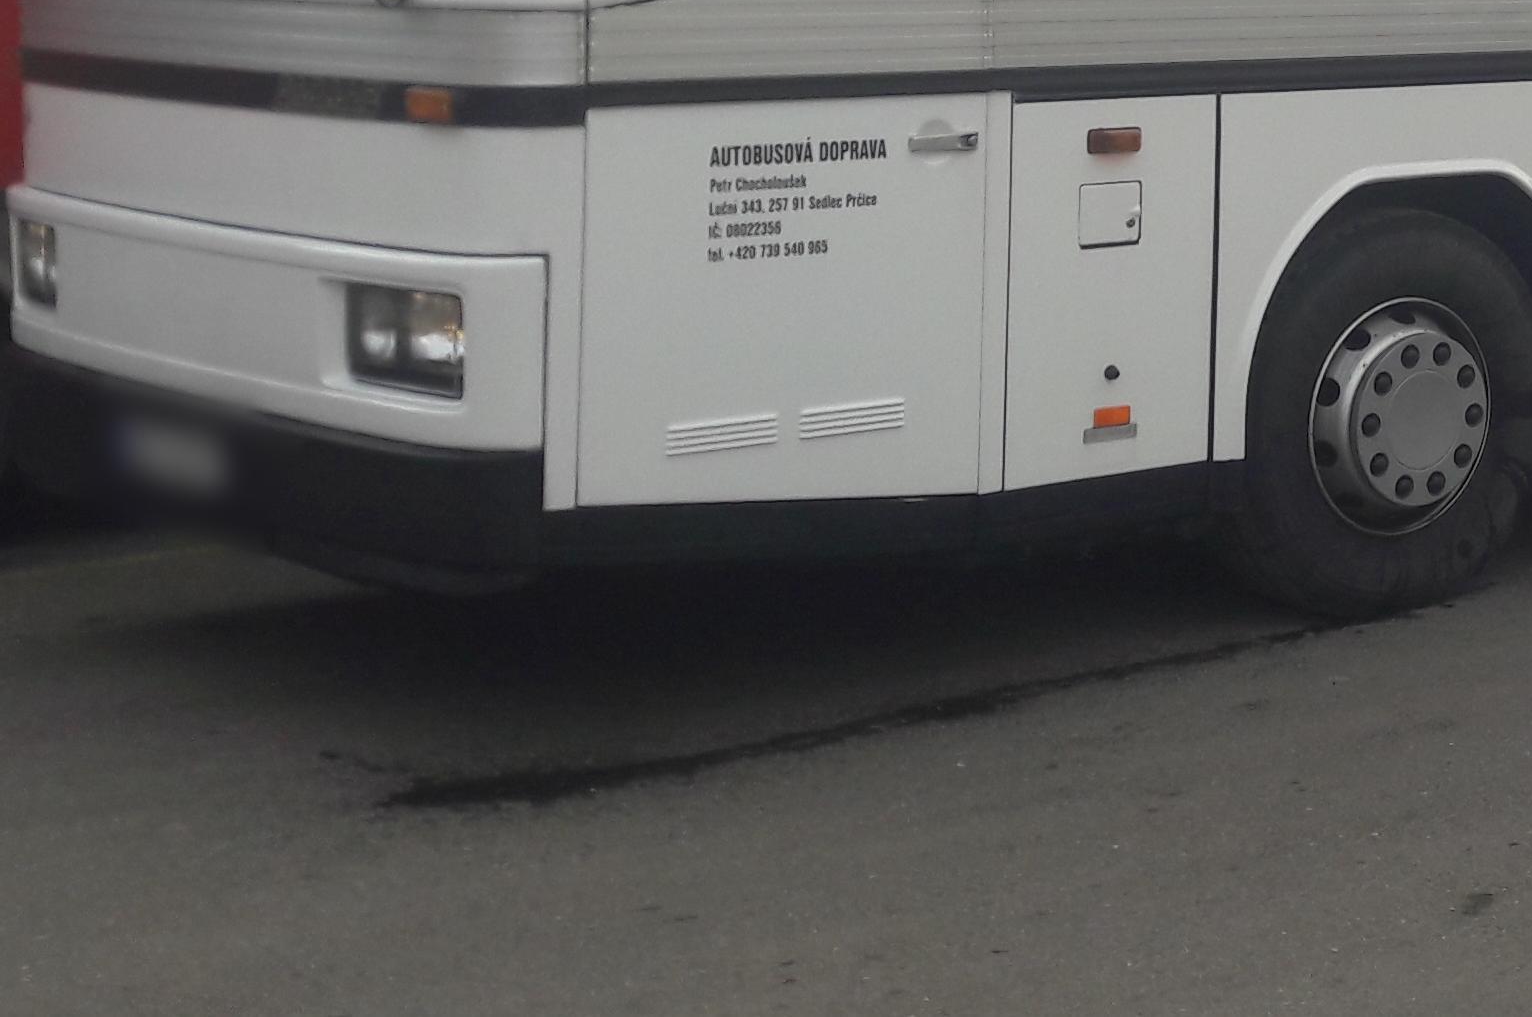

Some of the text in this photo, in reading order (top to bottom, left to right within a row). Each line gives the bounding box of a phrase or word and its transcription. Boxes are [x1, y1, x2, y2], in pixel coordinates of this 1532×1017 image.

[709, 137, 888, 167] AUTOBUSOVÁ DOPRAVA
[709, 177, 732, 193] Petr
[768, 197, 788, 213] 257
[791, 196, 805, 211] 91
[808, 194, 843, 210] Sedlec
[845, 192, 878, 208] Prčice
[707, 246, 725, 262] tel.
[728, 244, 756, 260] +420
[760, 242, 780, 258] 739
[783, 241, 805, 256] 540
